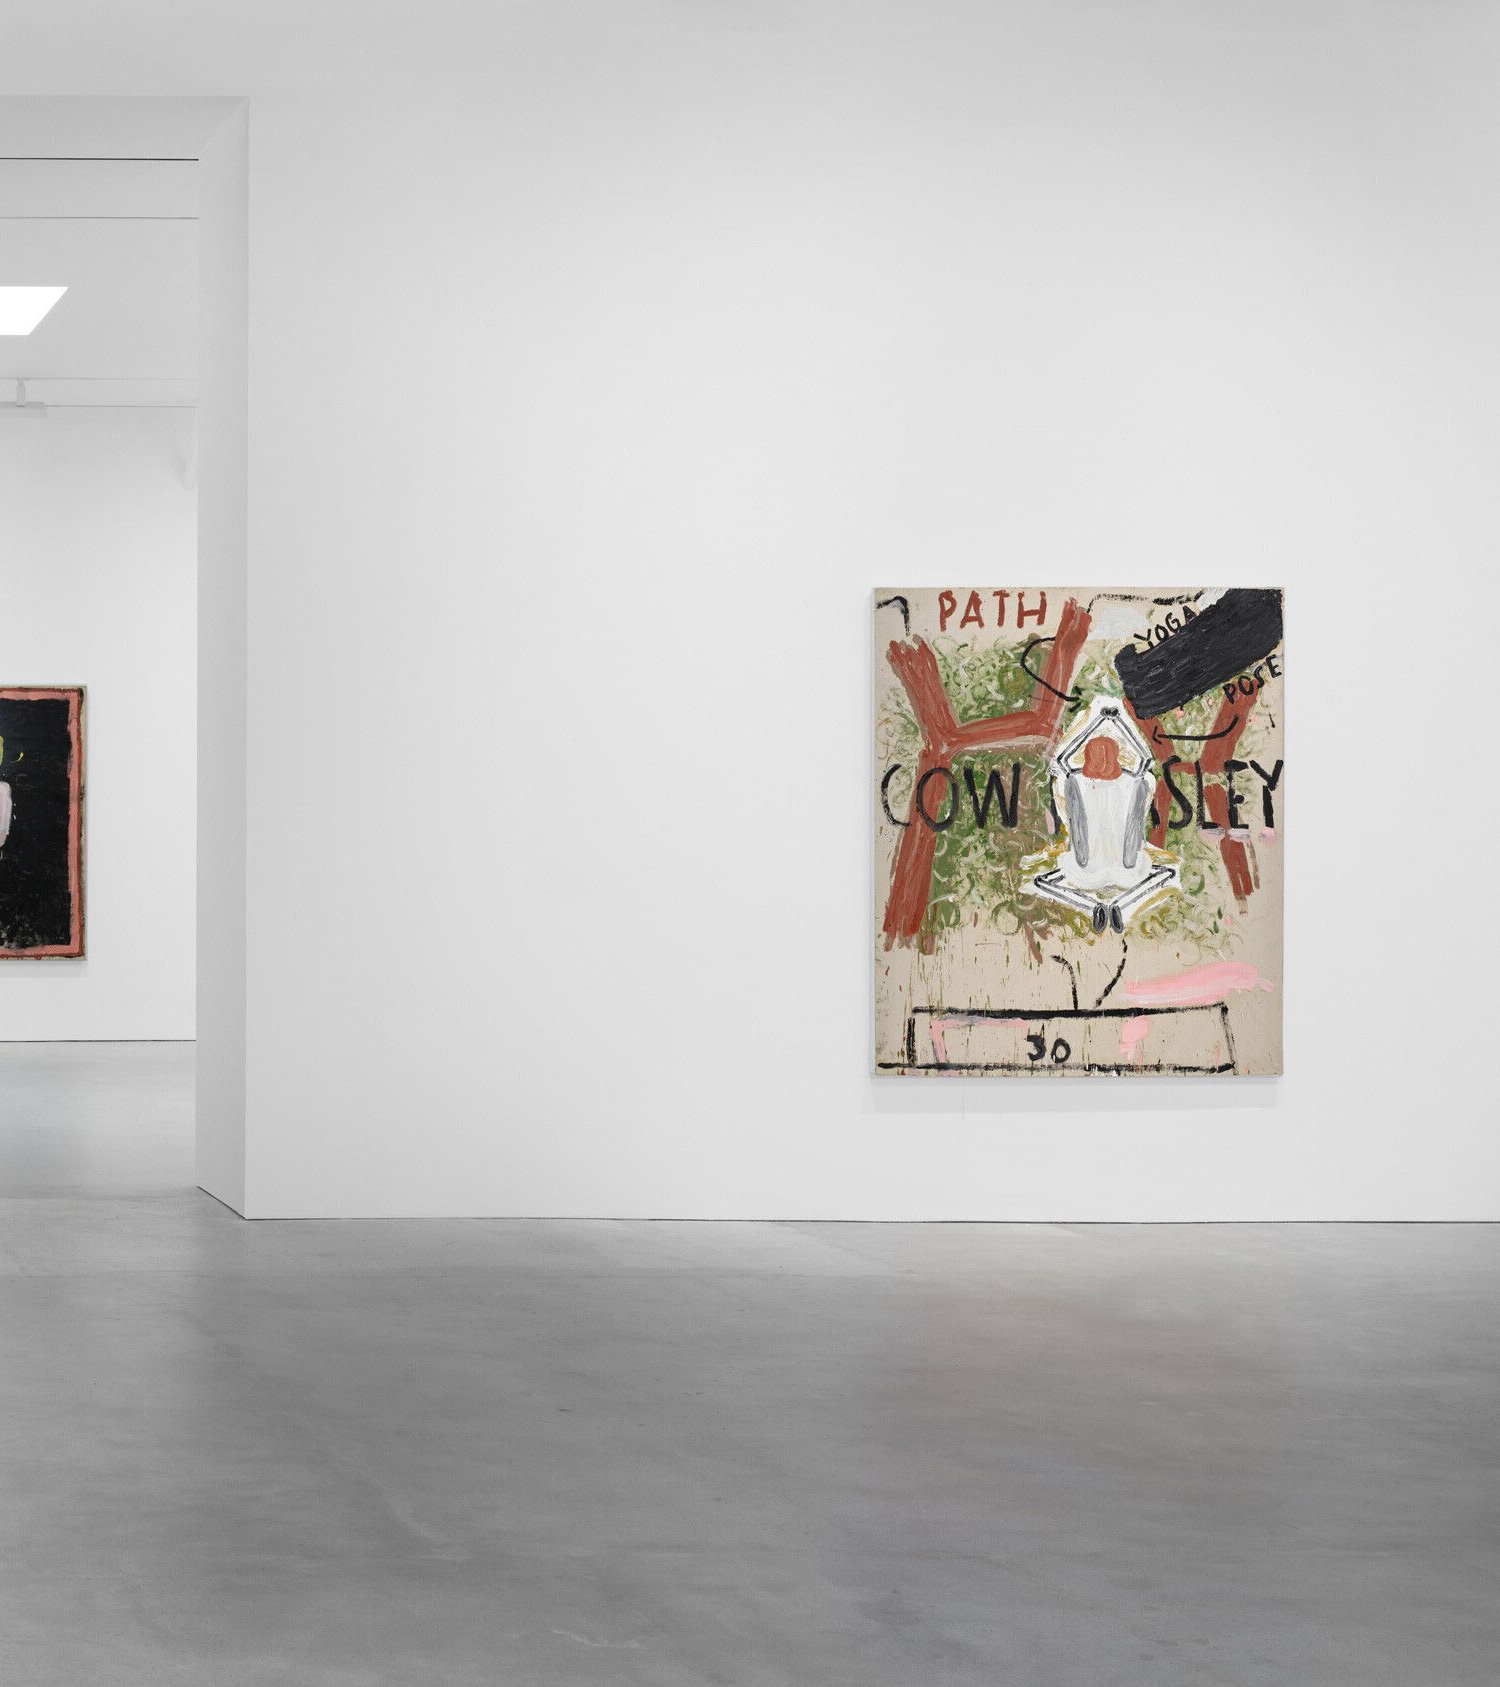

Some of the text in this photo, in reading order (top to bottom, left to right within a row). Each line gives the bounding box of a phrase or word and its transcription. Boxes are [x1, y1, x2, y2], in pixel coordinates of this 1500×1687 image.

[939, 590, 1047, 631] PATH
[1134, 606, 1200, 647] YOGA
[1223, 655, 1282, 704] POSE
[881, 763, 1021, 832] COW
[1026, 1034, 1071, 1064] 30
